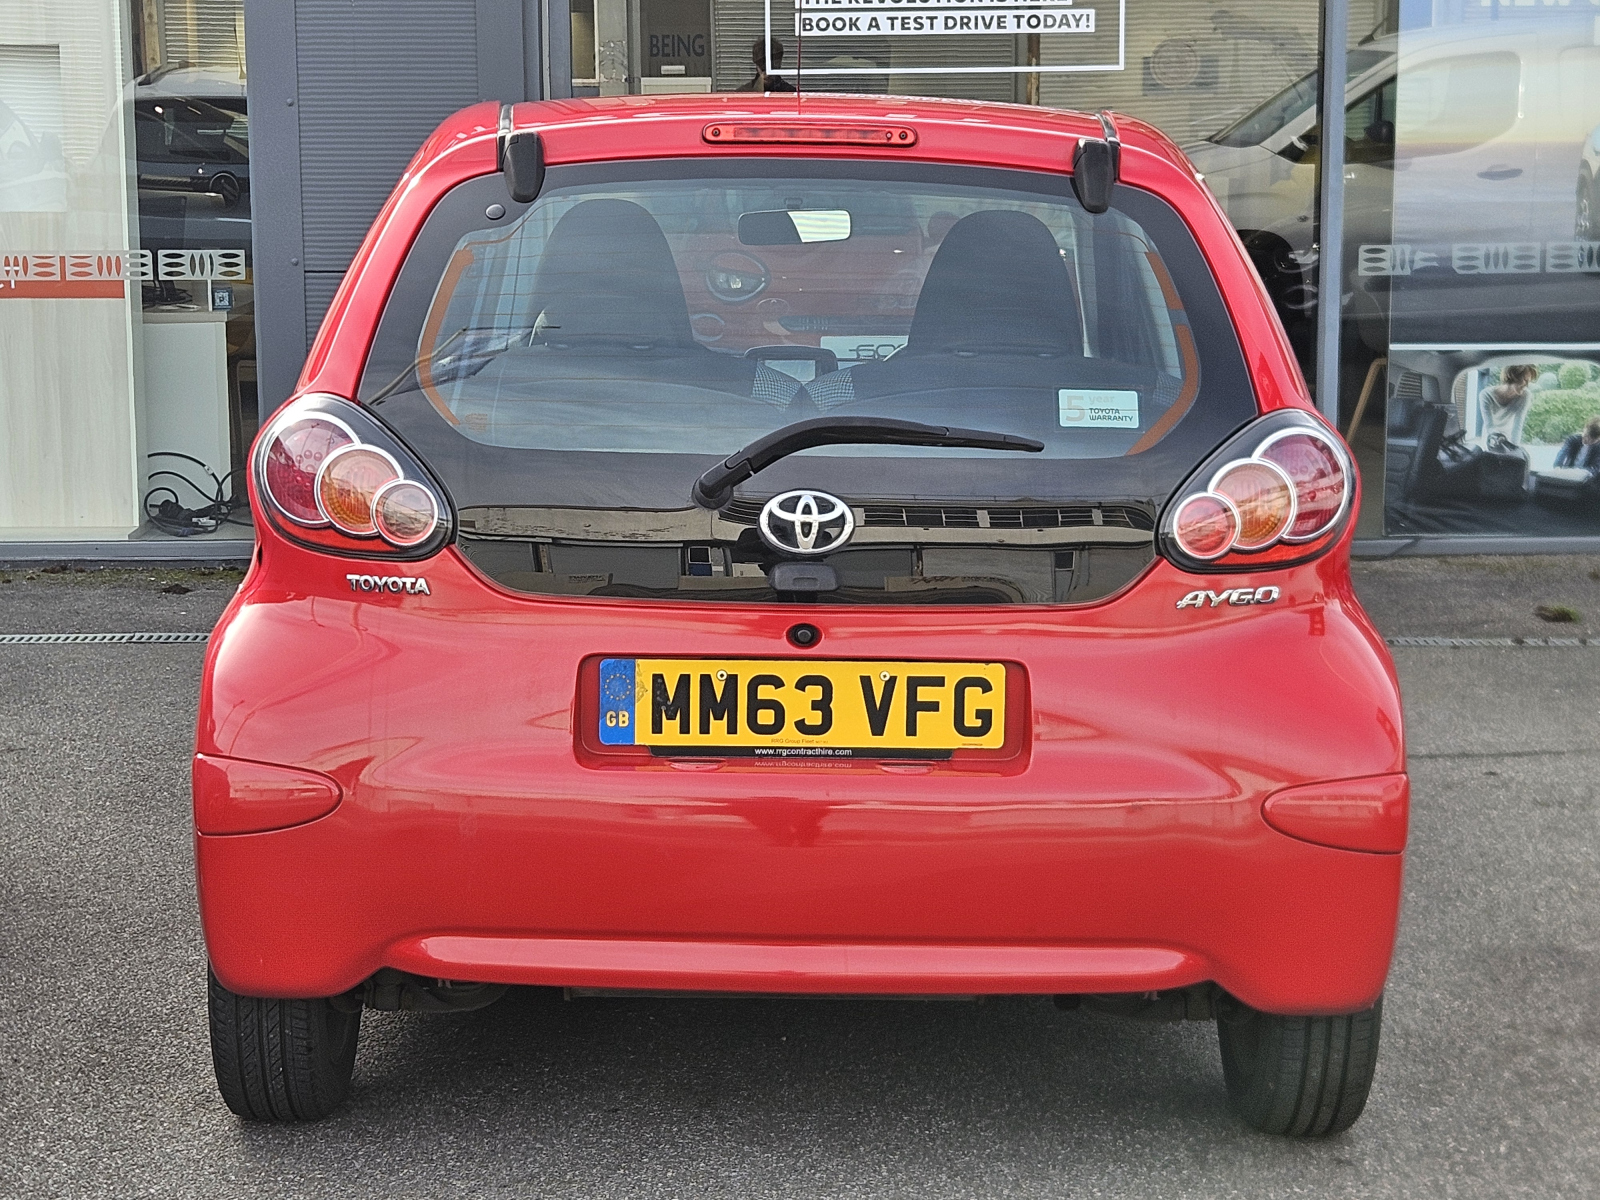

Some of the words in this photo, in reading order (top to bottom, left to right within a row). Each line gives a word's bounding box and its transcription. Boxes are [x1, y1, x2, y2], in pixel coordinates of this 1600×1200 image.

[802, 16, 861, 32] BOOK
[867, 16, 881, 31] A
[886, 15, 938, 31] TEST
[943, 15, 1007, 30] DRIVE
[1013, 13, 1090, 30] TODAY!
[649, 33, 705, 57] BEING
[1066, 395, 1085, 421] 5
[1088, 395, 1115, 405] year
[1088, 407, 1121, 415] TOYOTA
[1089, 414, 1134, 422] WARRANTY
[345, 573, 431, 595] TOYOTA
[1176, 585, 1280, 609] AYGO
[650, 673, 834, 736] MM63
[859, 675, 994, 738] VFG
[605, 710, 630, 728] GB
[754, 748, 852, 756] www.rrgcontracthire.com
